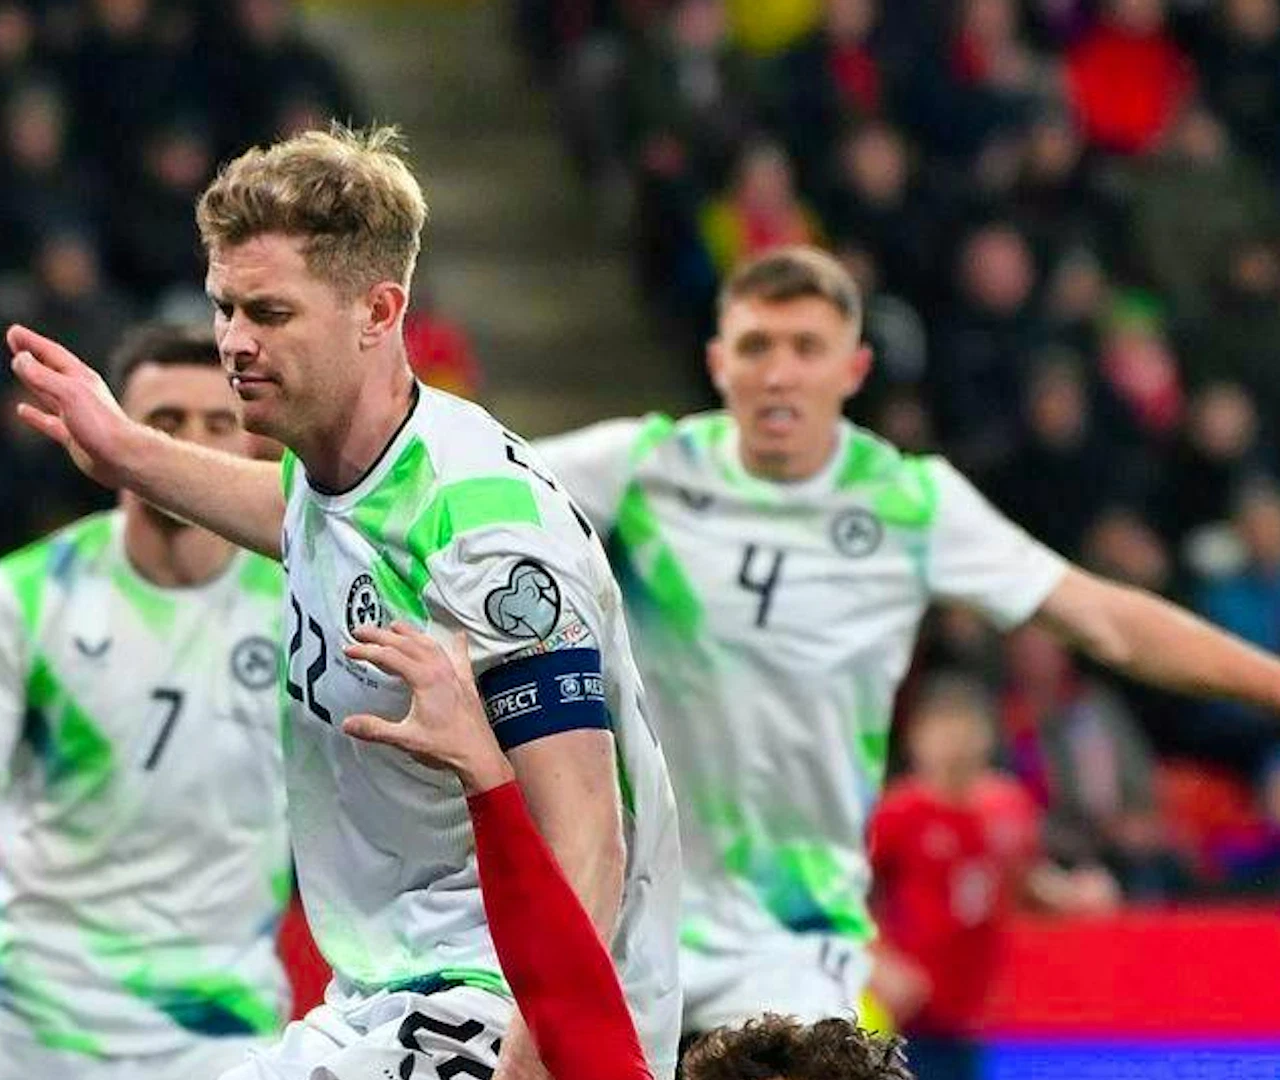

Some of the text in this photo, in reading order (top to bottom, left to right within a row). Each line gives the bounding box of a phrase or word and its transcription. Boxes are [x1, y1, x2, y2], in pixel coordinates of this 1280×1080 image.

[738, 543, 786, 628] 4
[286, 592, 333, 725] 22
[584, 678, 604, 696] RES
[143, 687, 185, 771] 7
[491, 688, 538, 719] SPECT
